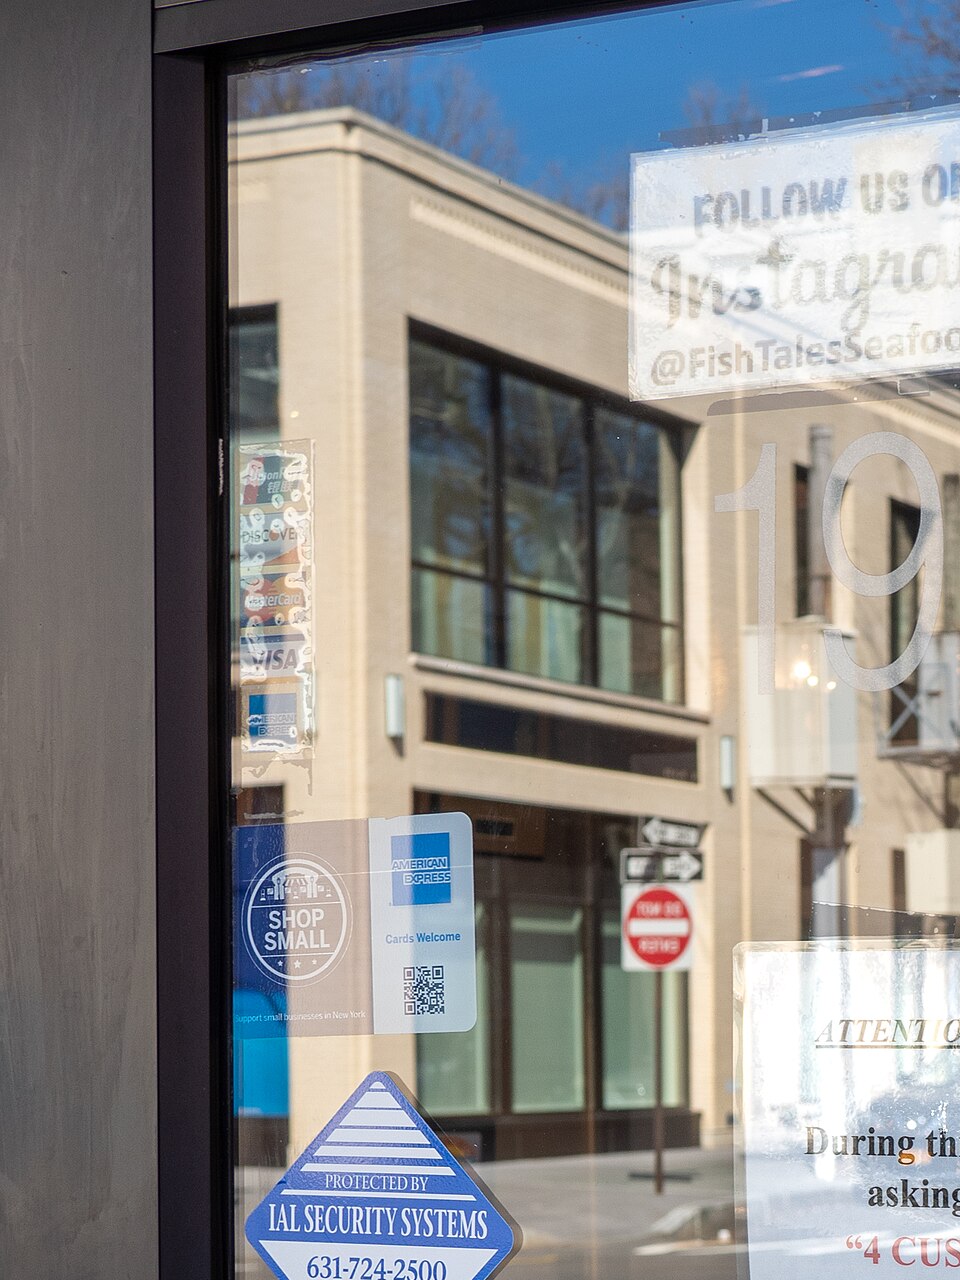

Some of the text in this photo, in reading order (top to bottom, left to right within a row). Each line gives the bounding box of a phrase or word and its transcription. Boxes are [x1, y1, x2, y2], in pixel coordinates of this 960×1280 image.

[694, 176, 848, 236] FOLLOW
[859, 168, 910, 215] US
[242, 527, 300, 543] DISCOVE
[258, 725, 296, 736] EXPRES
[391, 857, 448, 871] AMERICAN
[402, 871, 452, 886] EXPRESS
[268, 907, 325, 931] SHOP
[264, 928, 330, 952] SMALL
[385, 930, 461, 945] Cards Welcome
[235, 1014, 262, 1024] Support
[264, 1013, 282, 1022] small
[284, 1012, 322, 1022] businesses
[332, 1011, 348, 1020] New
[349, 1010, 366, 1018] York
[804, 1124, 916, 1166] During
[325, 1174, 429, 1192] PROTECTED BY
[268, 1204, 488, 1240] IAL SECURITY SYSTEMS
